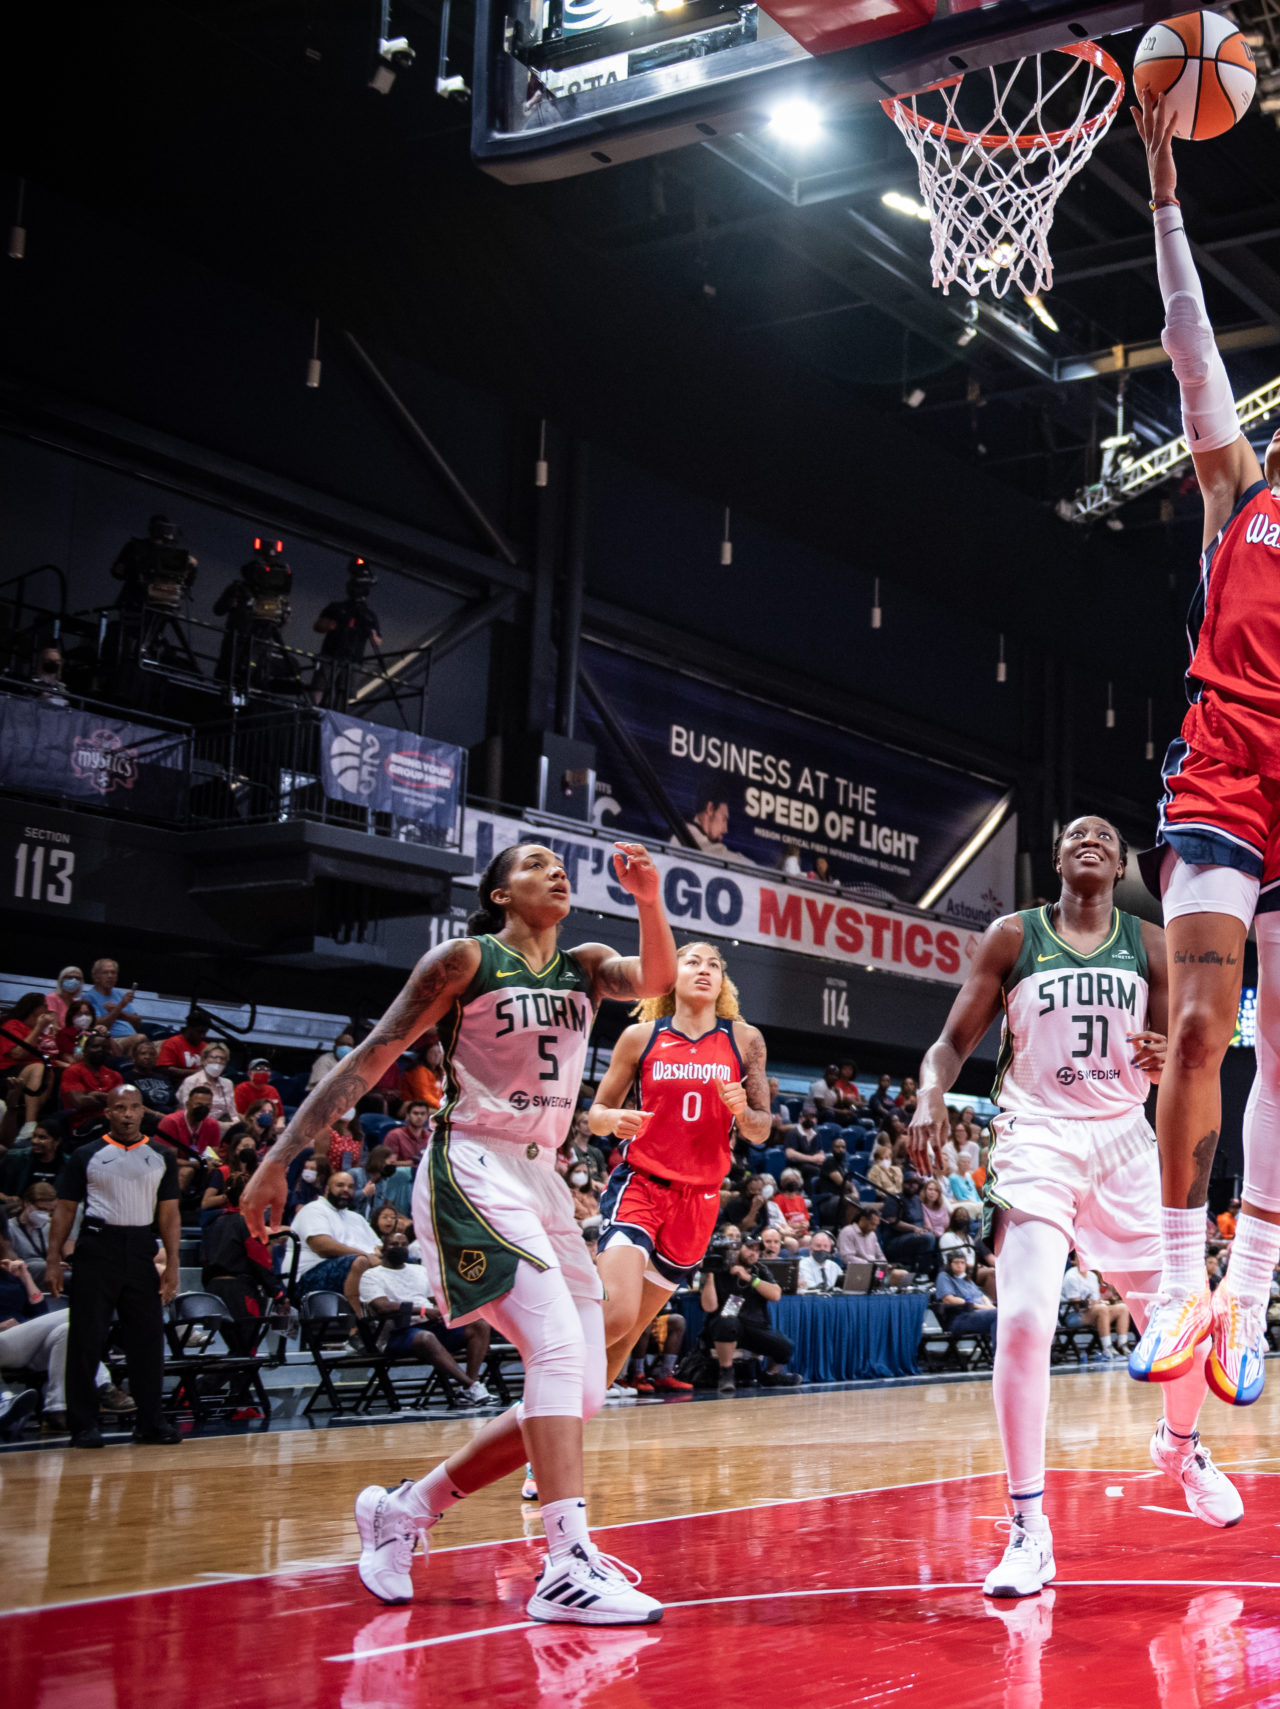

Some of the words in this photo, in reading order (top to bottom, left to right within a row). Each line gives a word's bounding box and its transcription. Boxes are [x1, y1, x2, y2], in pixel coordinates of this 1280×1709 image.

[670, 724, 791, 789] BUSINESS
[798, 767, 829, 800] AT
[835, 777, 877, 816] THE
[24, 826, 71, 844] SECTION
[745, 786, 819, 833] SPEED
[824, 811, 855, 843] OF
[859, 820, 919, 862] LIGHT
[754, 826, 781, 842] MISSION
[782, 834, 810, 850] CRITICAL
[14, 843, 75, 904] 113
[664, 866, 743, 926] GO
[758, 887, 960, 974] MYSTICS
[946, 900, 992, 923] Astound
[495, 993, 586, 1039] STORM
[822, 988, 850, 1029] 114
[1039, 972, 1136, 1017] STORM
[538, 1035, 559, 1081] 5
[1071, 1015, 1109, 1058] 31
[652, 1060, 731, 1084] Washington
[1078, 1069, 1121, 1081] SWEDISH
[682, 1091, 702, 1122] 0
